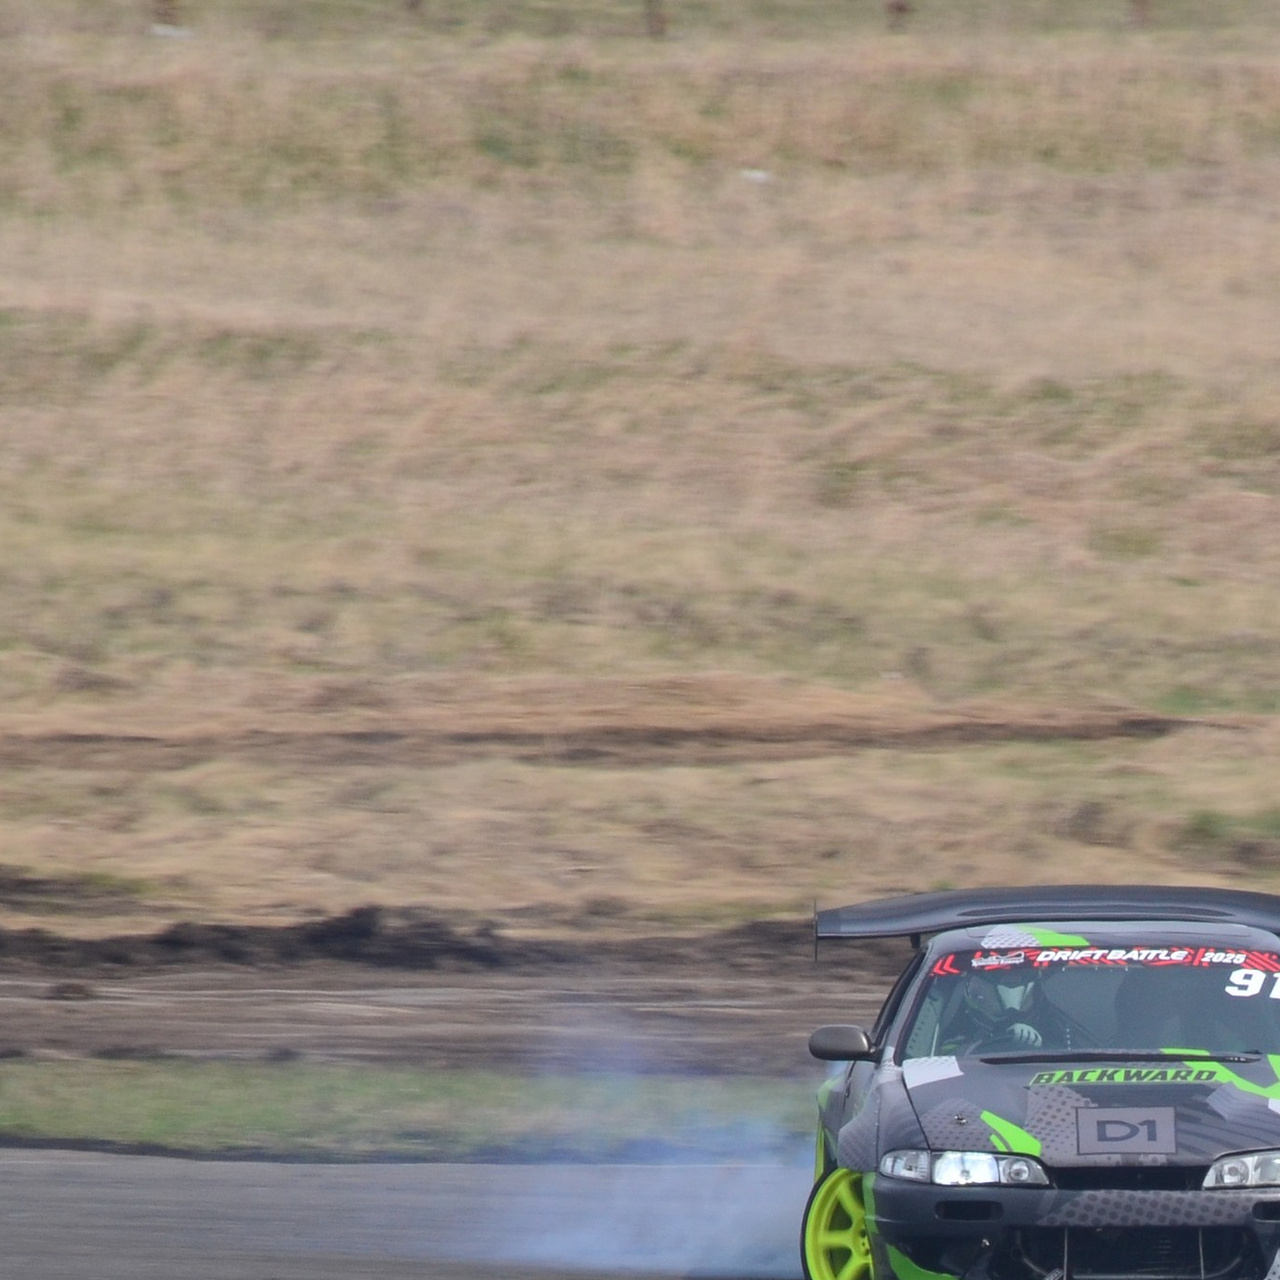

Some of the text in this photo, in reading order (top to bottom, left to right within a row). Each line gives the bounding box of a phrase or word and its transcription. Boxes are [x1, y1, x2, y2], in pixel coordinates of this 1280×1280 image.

[1036, 949, 1247, 964] DRIFT BATTLE 2025
[1031, 1068, 1218, 1085] BACKWARD
[1096, 1118, 1158, 1142] D1
